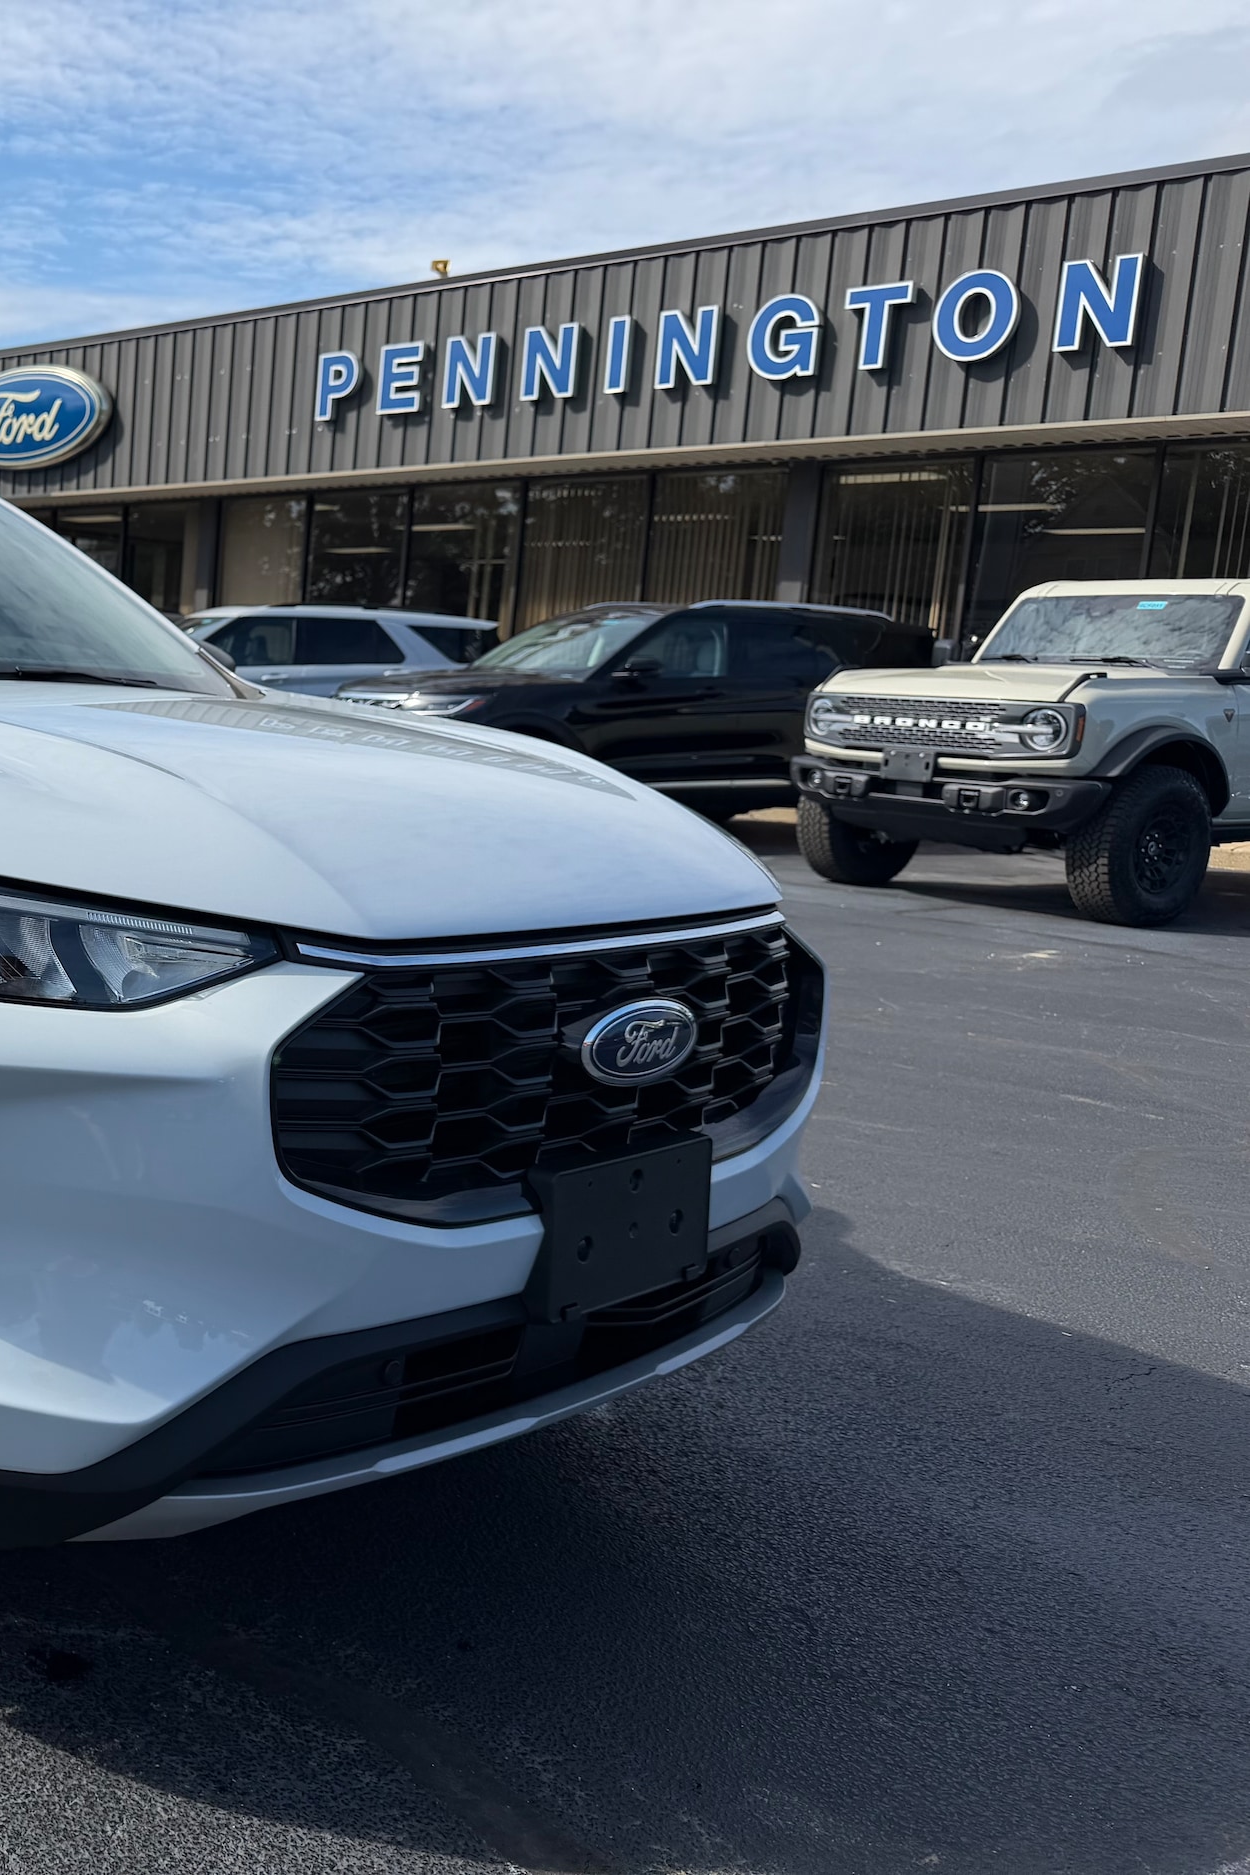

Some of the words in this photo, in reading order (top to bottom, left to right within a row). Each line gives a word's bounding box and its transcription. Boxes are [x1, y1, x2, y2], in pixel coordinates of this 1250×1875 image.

[314, 252, 1144, 422] PENNINGTON
[853, 713, 986, 732] BRONCO
[616, 1019, 679, 1067] Ford
